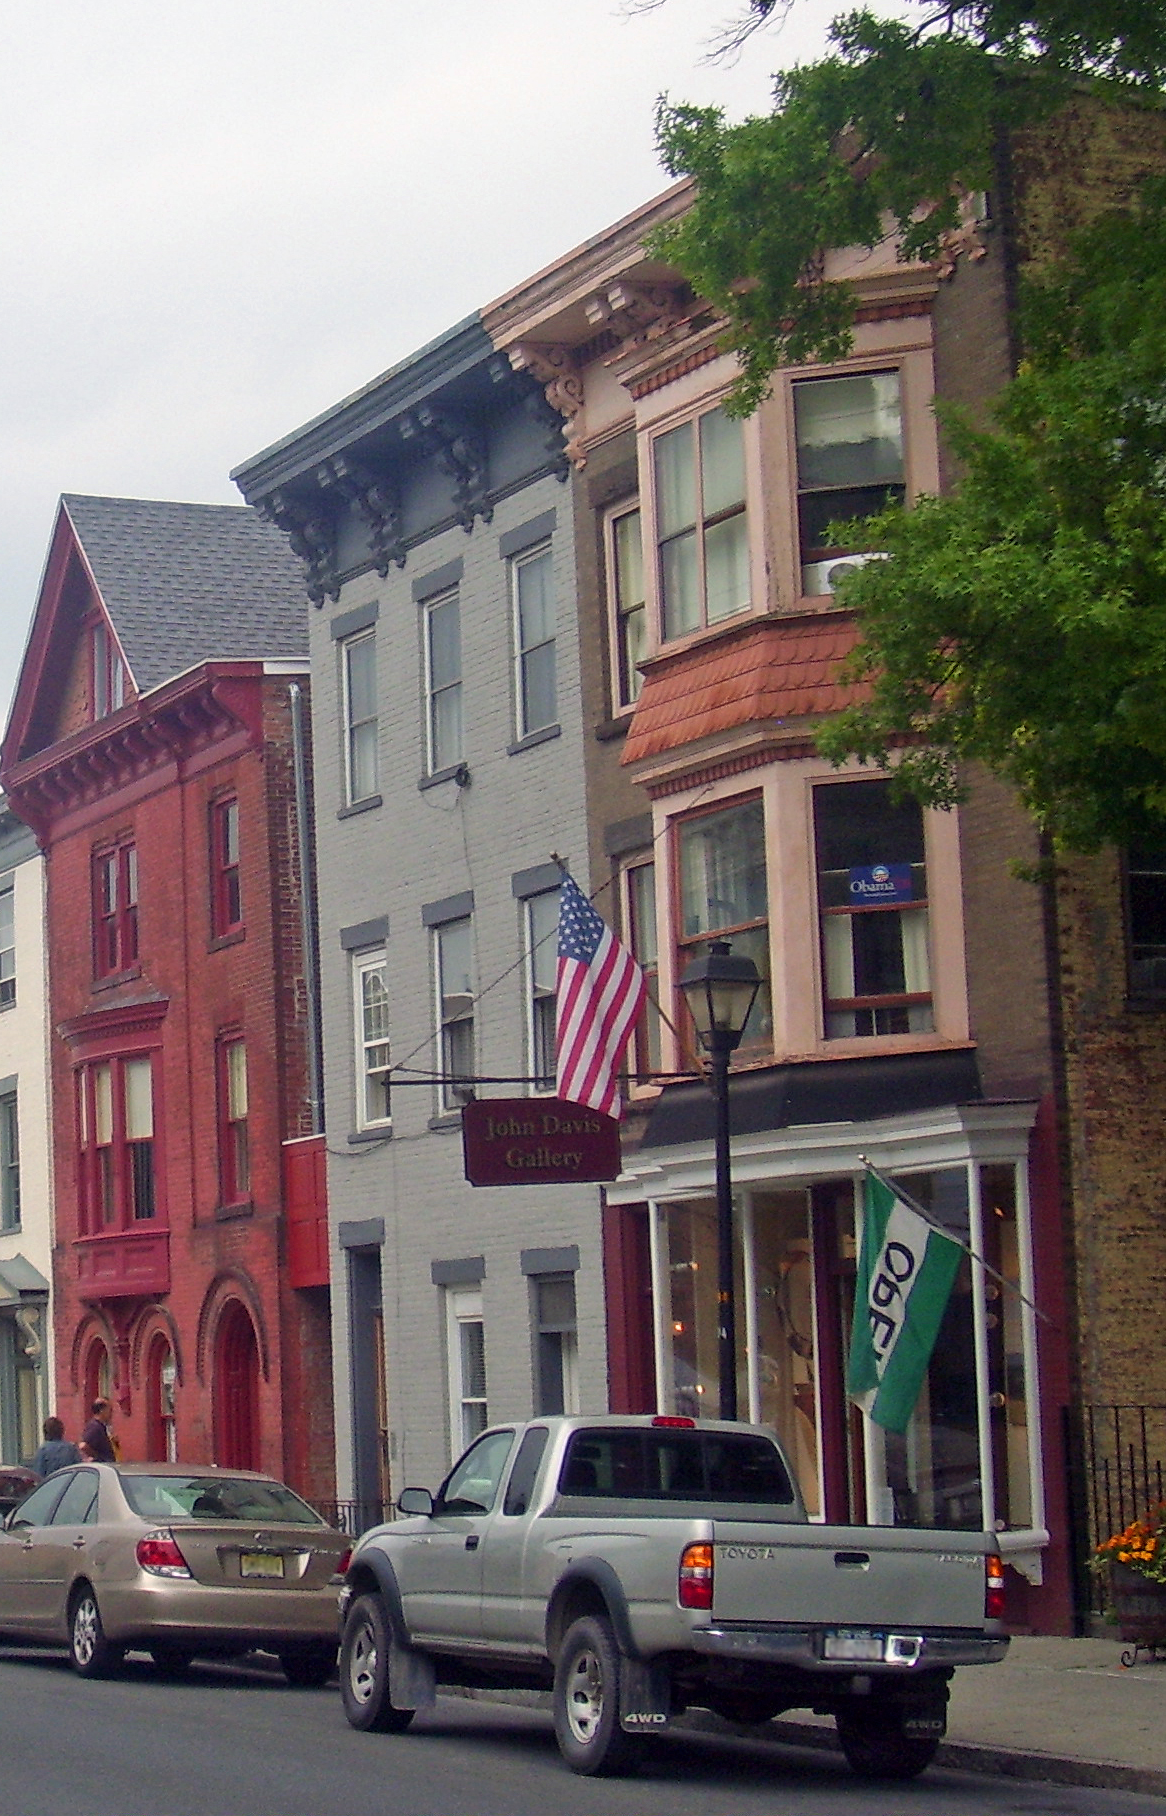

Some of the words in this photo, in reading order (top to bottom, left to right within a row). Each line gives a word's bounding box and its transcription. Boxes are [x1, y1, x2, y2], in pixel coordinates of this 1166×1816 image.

[850, 880, 894, 893] Obama
[484, 1115, 534, 1141] John
[542, 1114, 601, 1135] Davis
[505, 1148, 583, 1171] Gallery
[719, 1547, 775, 1560] TOYOTA
[625, 1713, 667, 1723] 4WD
